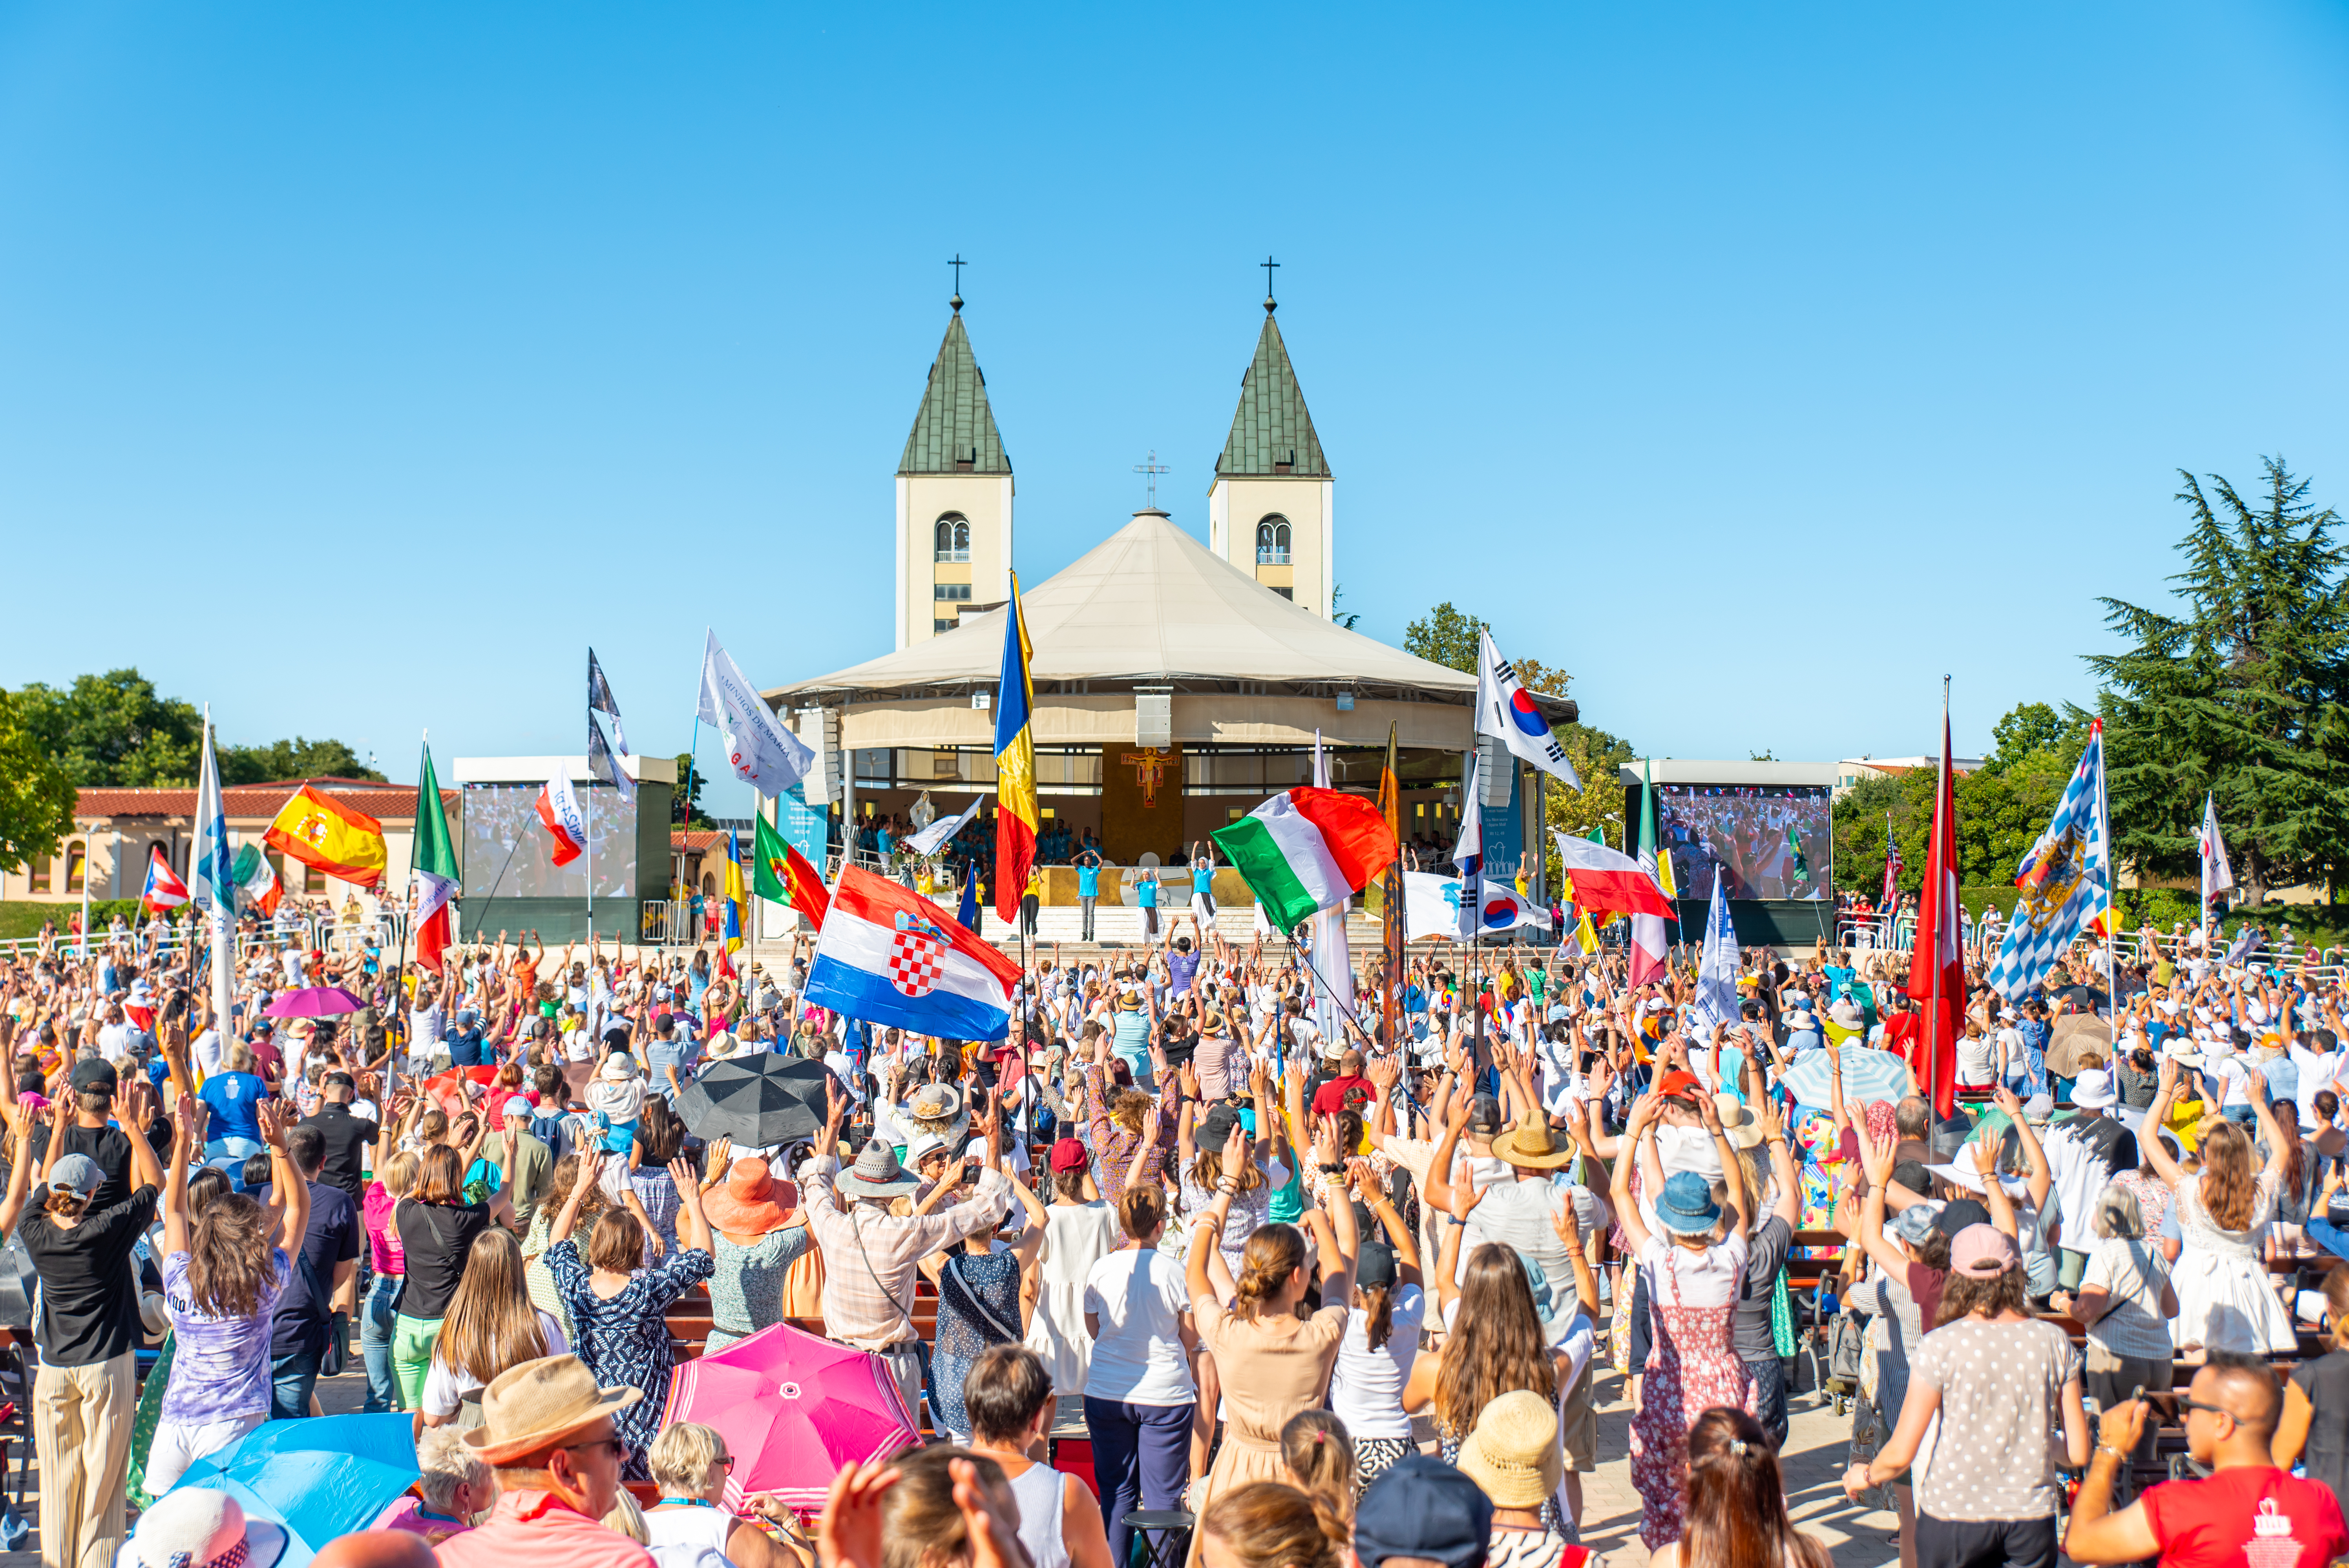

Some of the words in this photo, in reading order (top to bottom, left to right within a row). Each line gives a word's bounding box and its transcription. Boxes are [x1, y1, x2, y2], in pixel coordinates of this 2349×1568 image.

[752, 715, 765, 730] DE
[764, 730, 790, 758] MARIA
[1707, 1009, 1717, 1024] Regina
[1728, 1004, 1740, 1020] Sicilia
